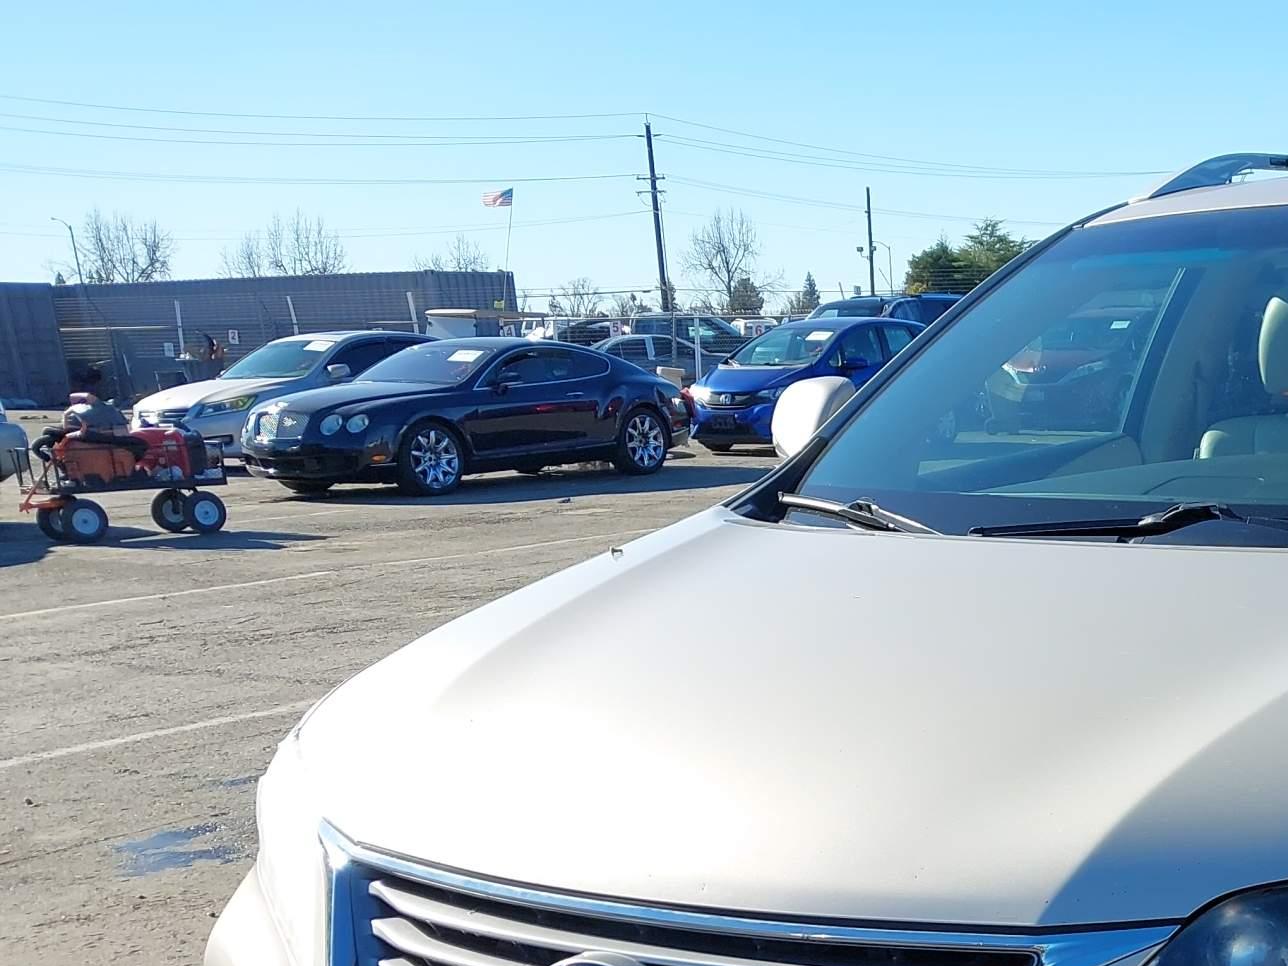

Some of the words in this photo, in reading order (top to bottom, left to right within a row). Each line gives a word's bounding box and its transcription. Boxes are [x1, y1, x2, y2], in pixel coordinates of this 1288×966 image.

[612, 322, 620, 334] 5
[755, 324, 764, 336] 6
[230, 331, 238, 341] 2
